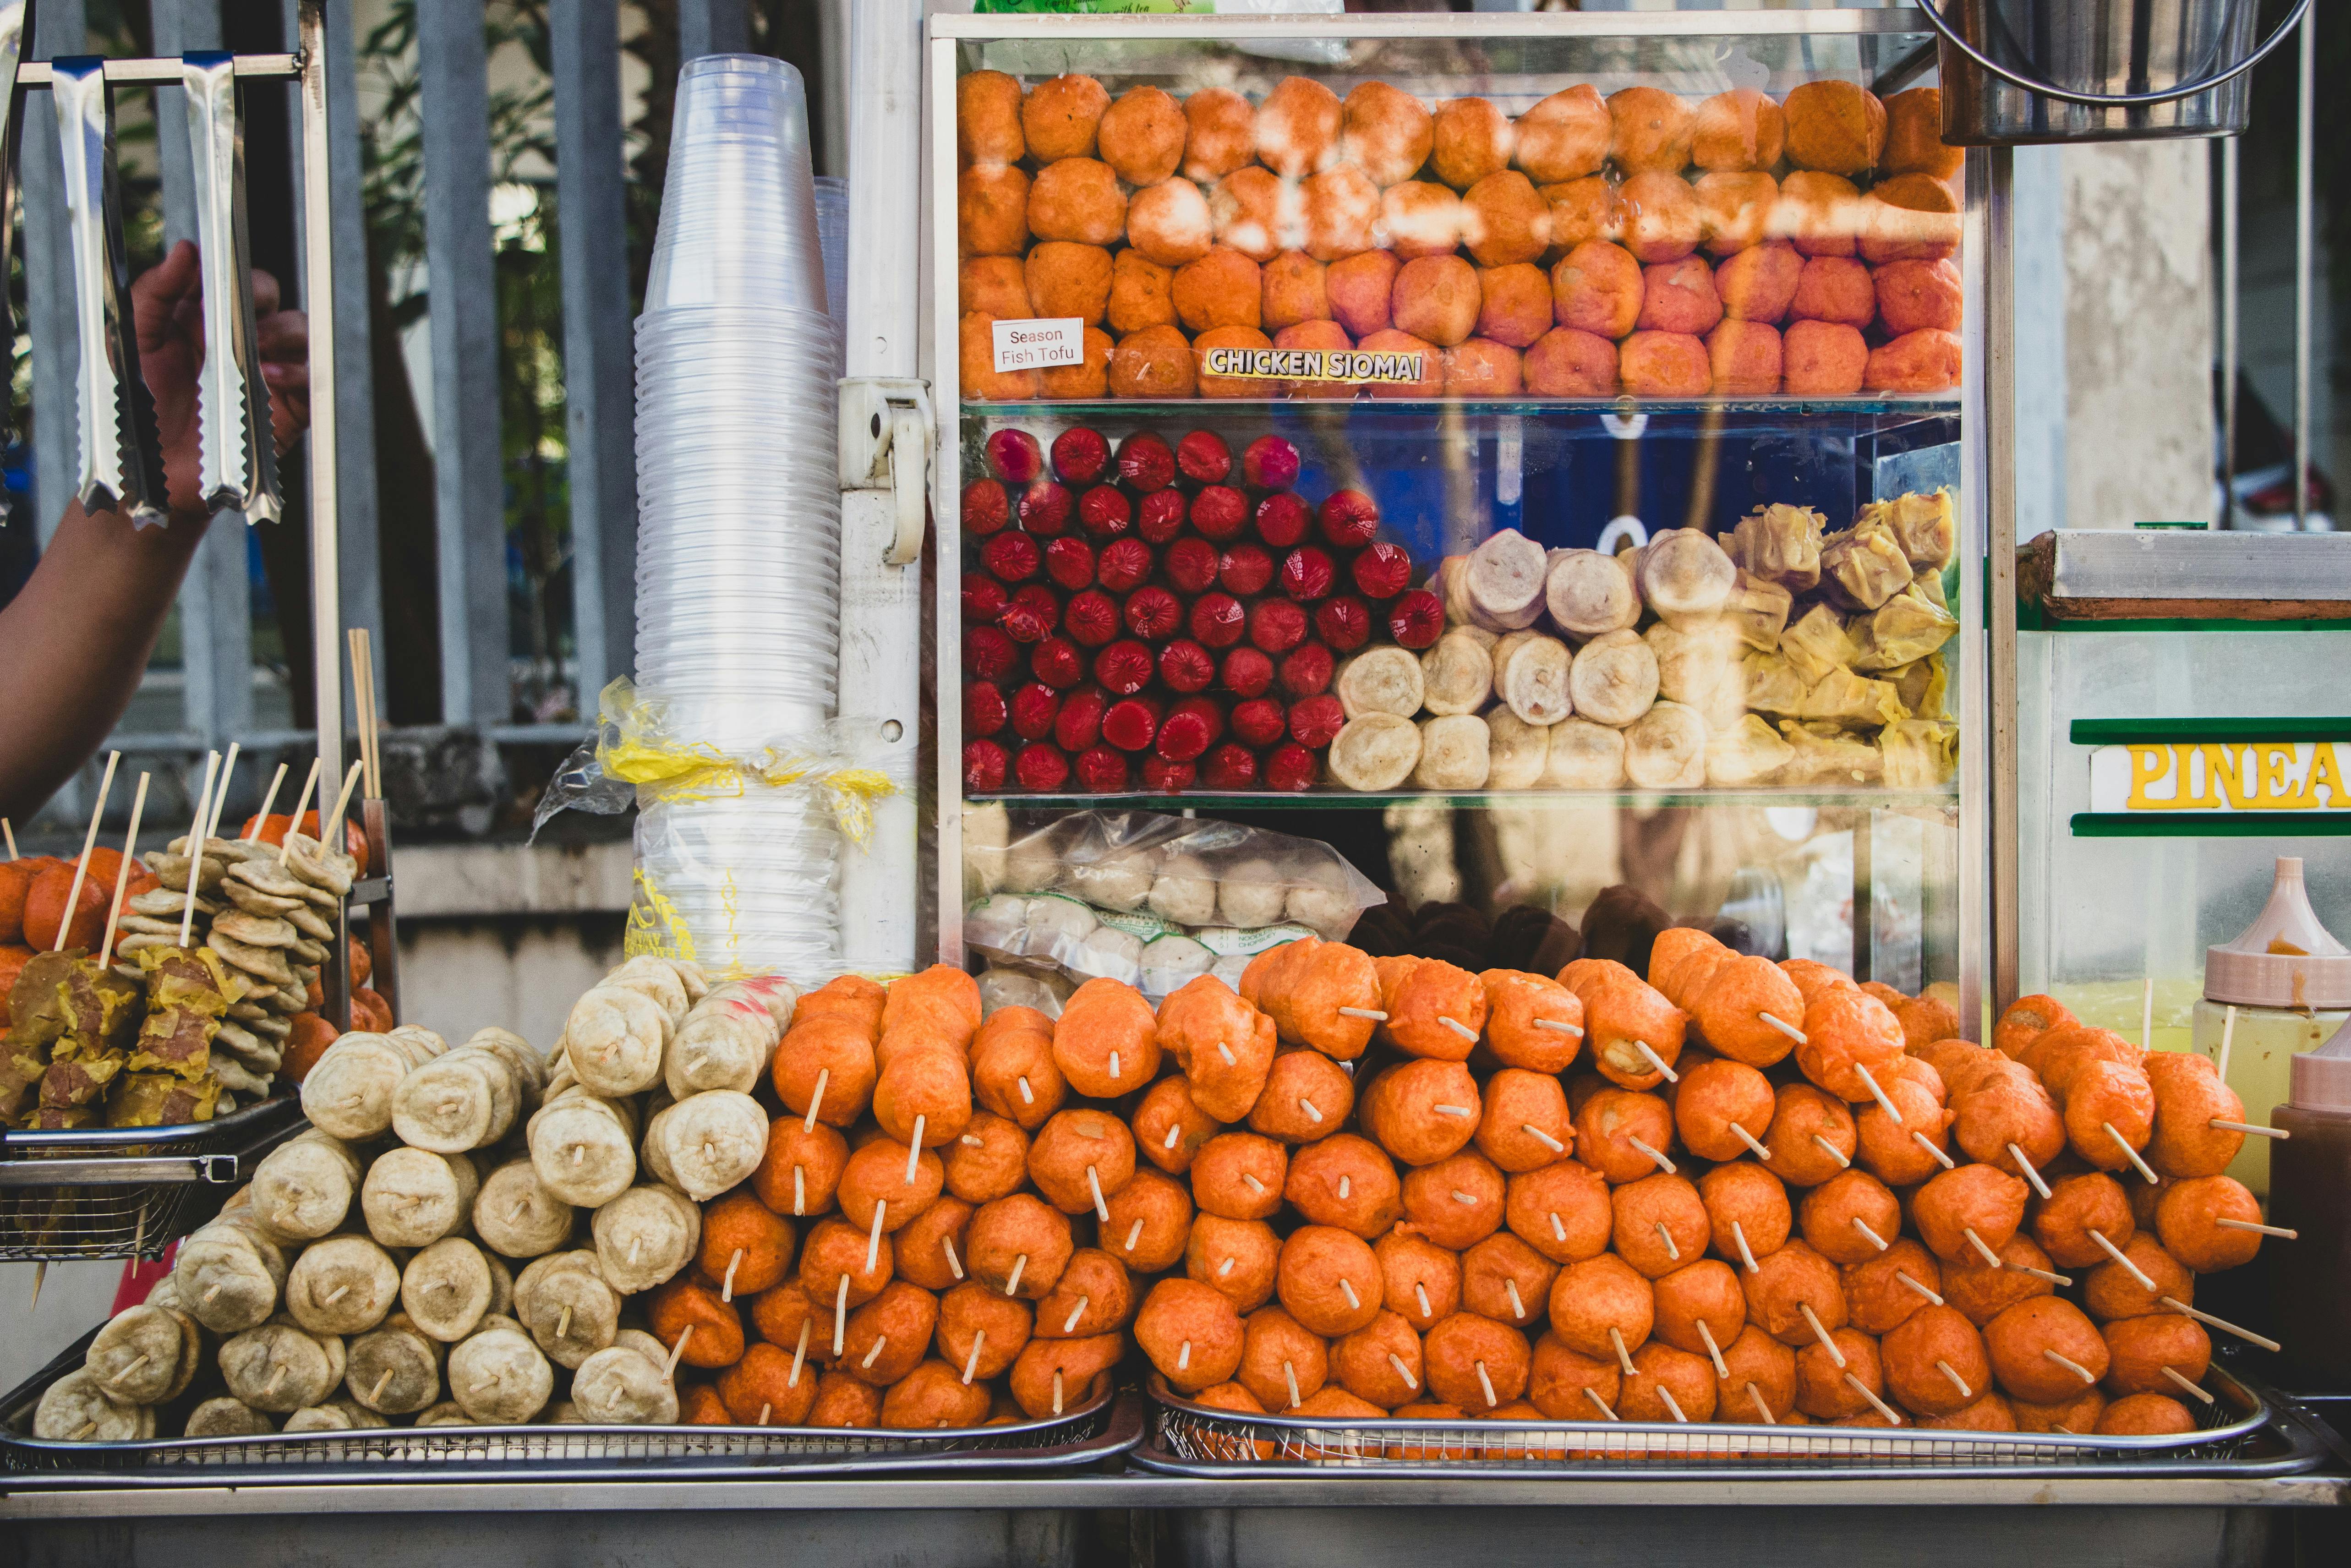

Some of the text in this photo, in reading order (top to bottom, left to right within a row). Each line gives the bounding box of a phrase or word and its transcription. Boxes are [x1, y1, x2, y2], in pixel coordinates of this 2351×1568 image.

[1010, 328, 1063, 344] Season
[1002, 345, 1075, 365] Fish Tofu
[1209, 348, 1422, 381] CHICKEN SIOMAI
[2126, 743, 2351, 809] PINEA
